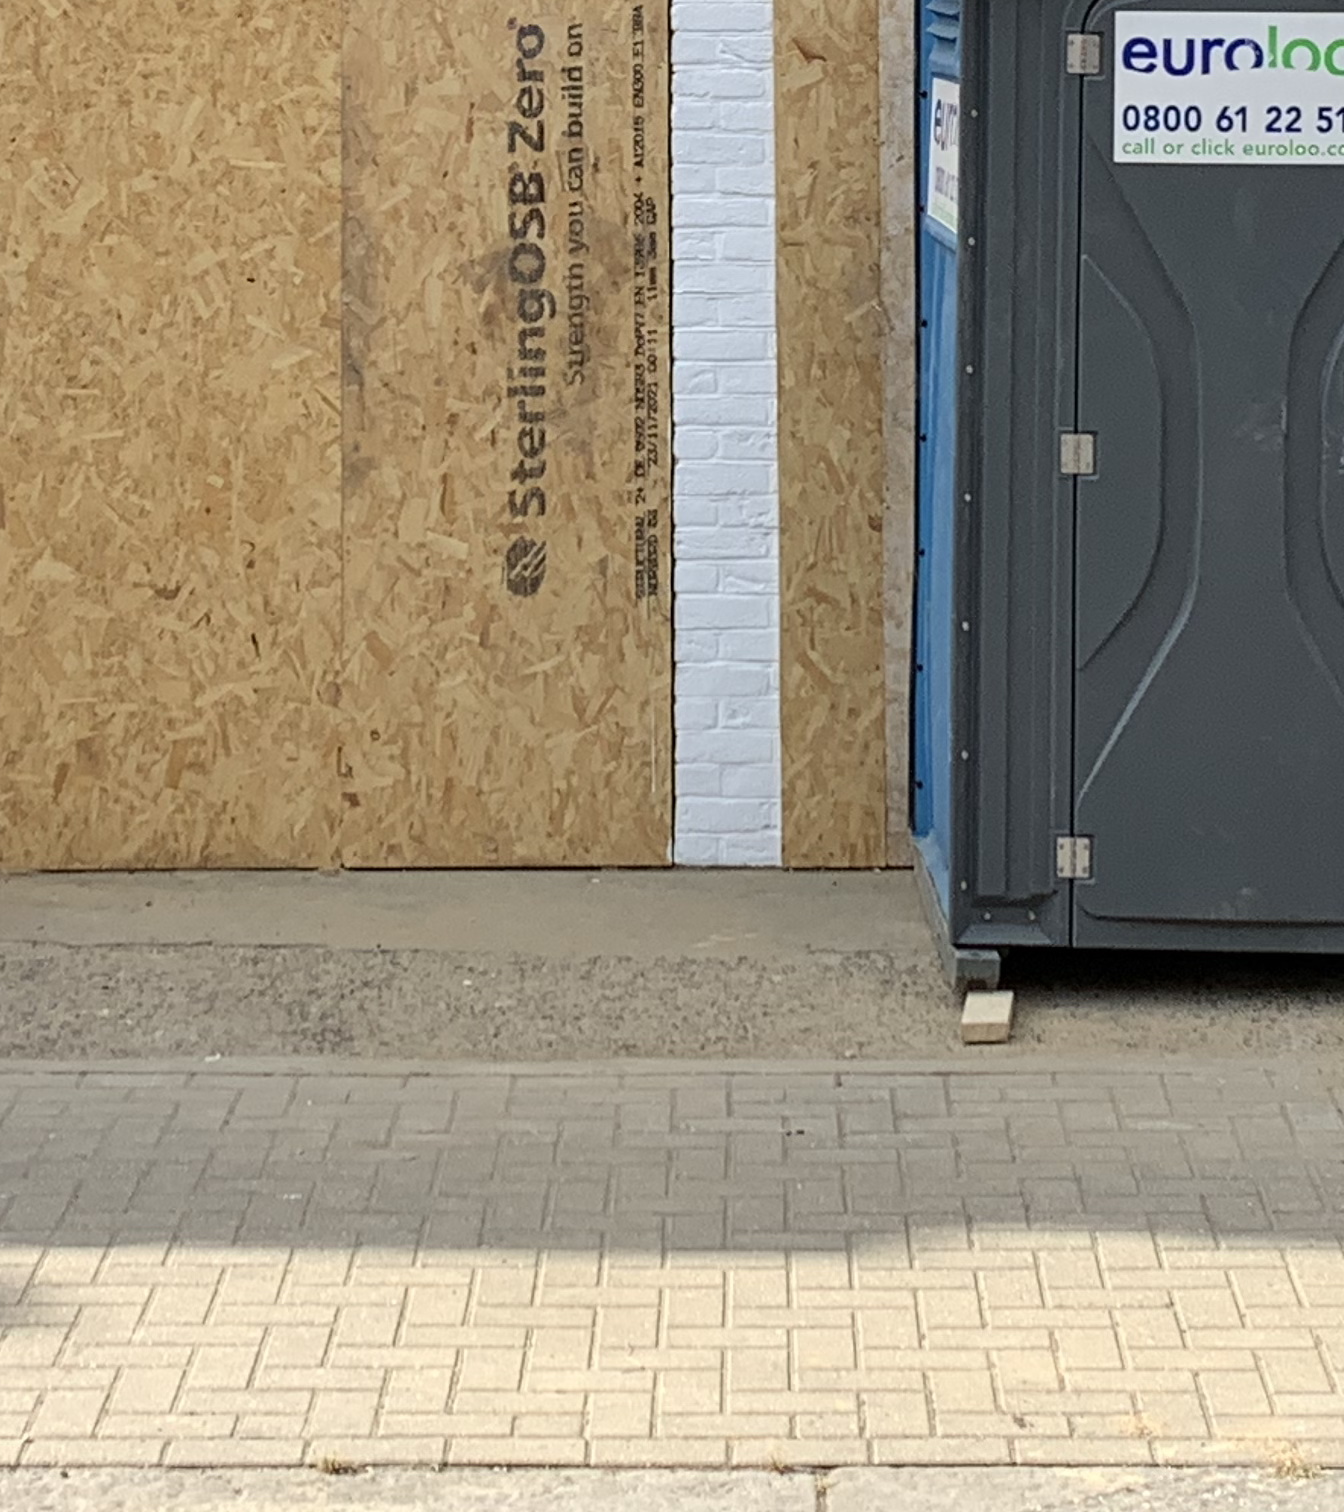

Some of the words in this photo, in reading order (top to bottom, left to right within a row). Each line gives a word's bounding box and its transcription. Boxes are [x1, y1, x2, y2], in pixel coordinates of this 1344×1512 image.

[566, 22, 585, 57] on
[506, 23, 546, 153] Zero
[560, 65, 585, 138] build
[1122, 105, 1202, 132] 0800
[1216, 105, 1248, 133] 61
[1265, 106, 1303, 133] 22
[566, 146, 585, 191] can
[1122, 139, 1155, 155] call
[1162, 141, 1184, 155] or
[1191, 140, 1235, 156] click
[566, 200, 589, 254] you
[562, 262, 590, 386] Strength
